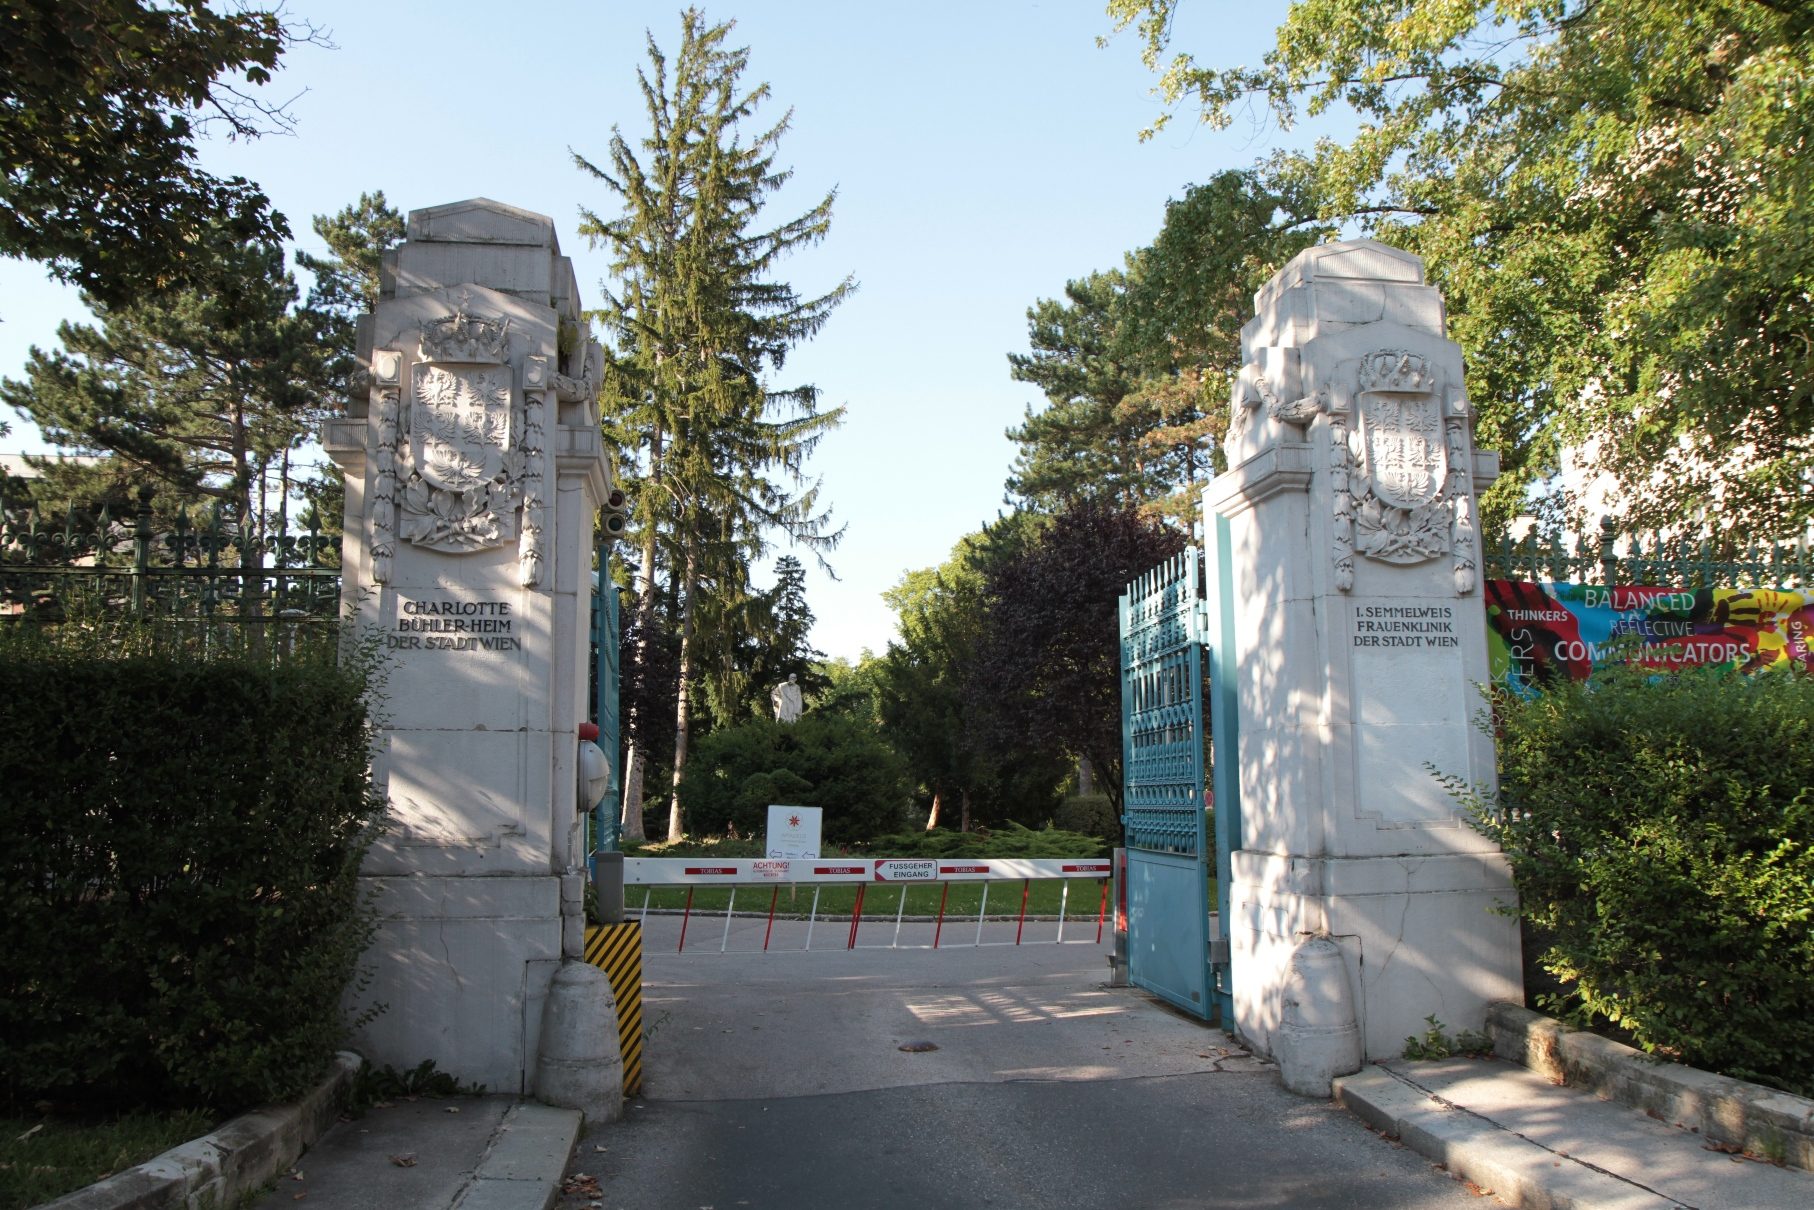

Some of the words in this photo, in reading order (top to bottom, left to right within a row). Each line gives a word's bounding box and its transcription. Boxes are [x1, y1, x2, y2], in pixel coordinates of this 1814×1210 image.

[1584, 589, 1696, 611] BALANCED
[403, 601, 512, 615] CHARLOTTE
[1366, 607, 1452, 618] SEMMELWEIS
[1507, 609, 1568, 621] THINKERS
[400, 616, 511, 633] BÜHLER-HEIM
[1357, 621, 1453, 632] FRAUENKLINIK
[387, 636, 421, 650] DER
[425, 636, 477, 651] STADT
[479, 636, 521, 651] WIEN
[1354, 636, 1380, 647] DER
[1382, 636, 1422, 647] STADT
[1424, 636, 1458, 647] WIEN
[1554, 640, 1751, 663] COMUNICATORS
[893, 870, 929, 878] EINGANG
